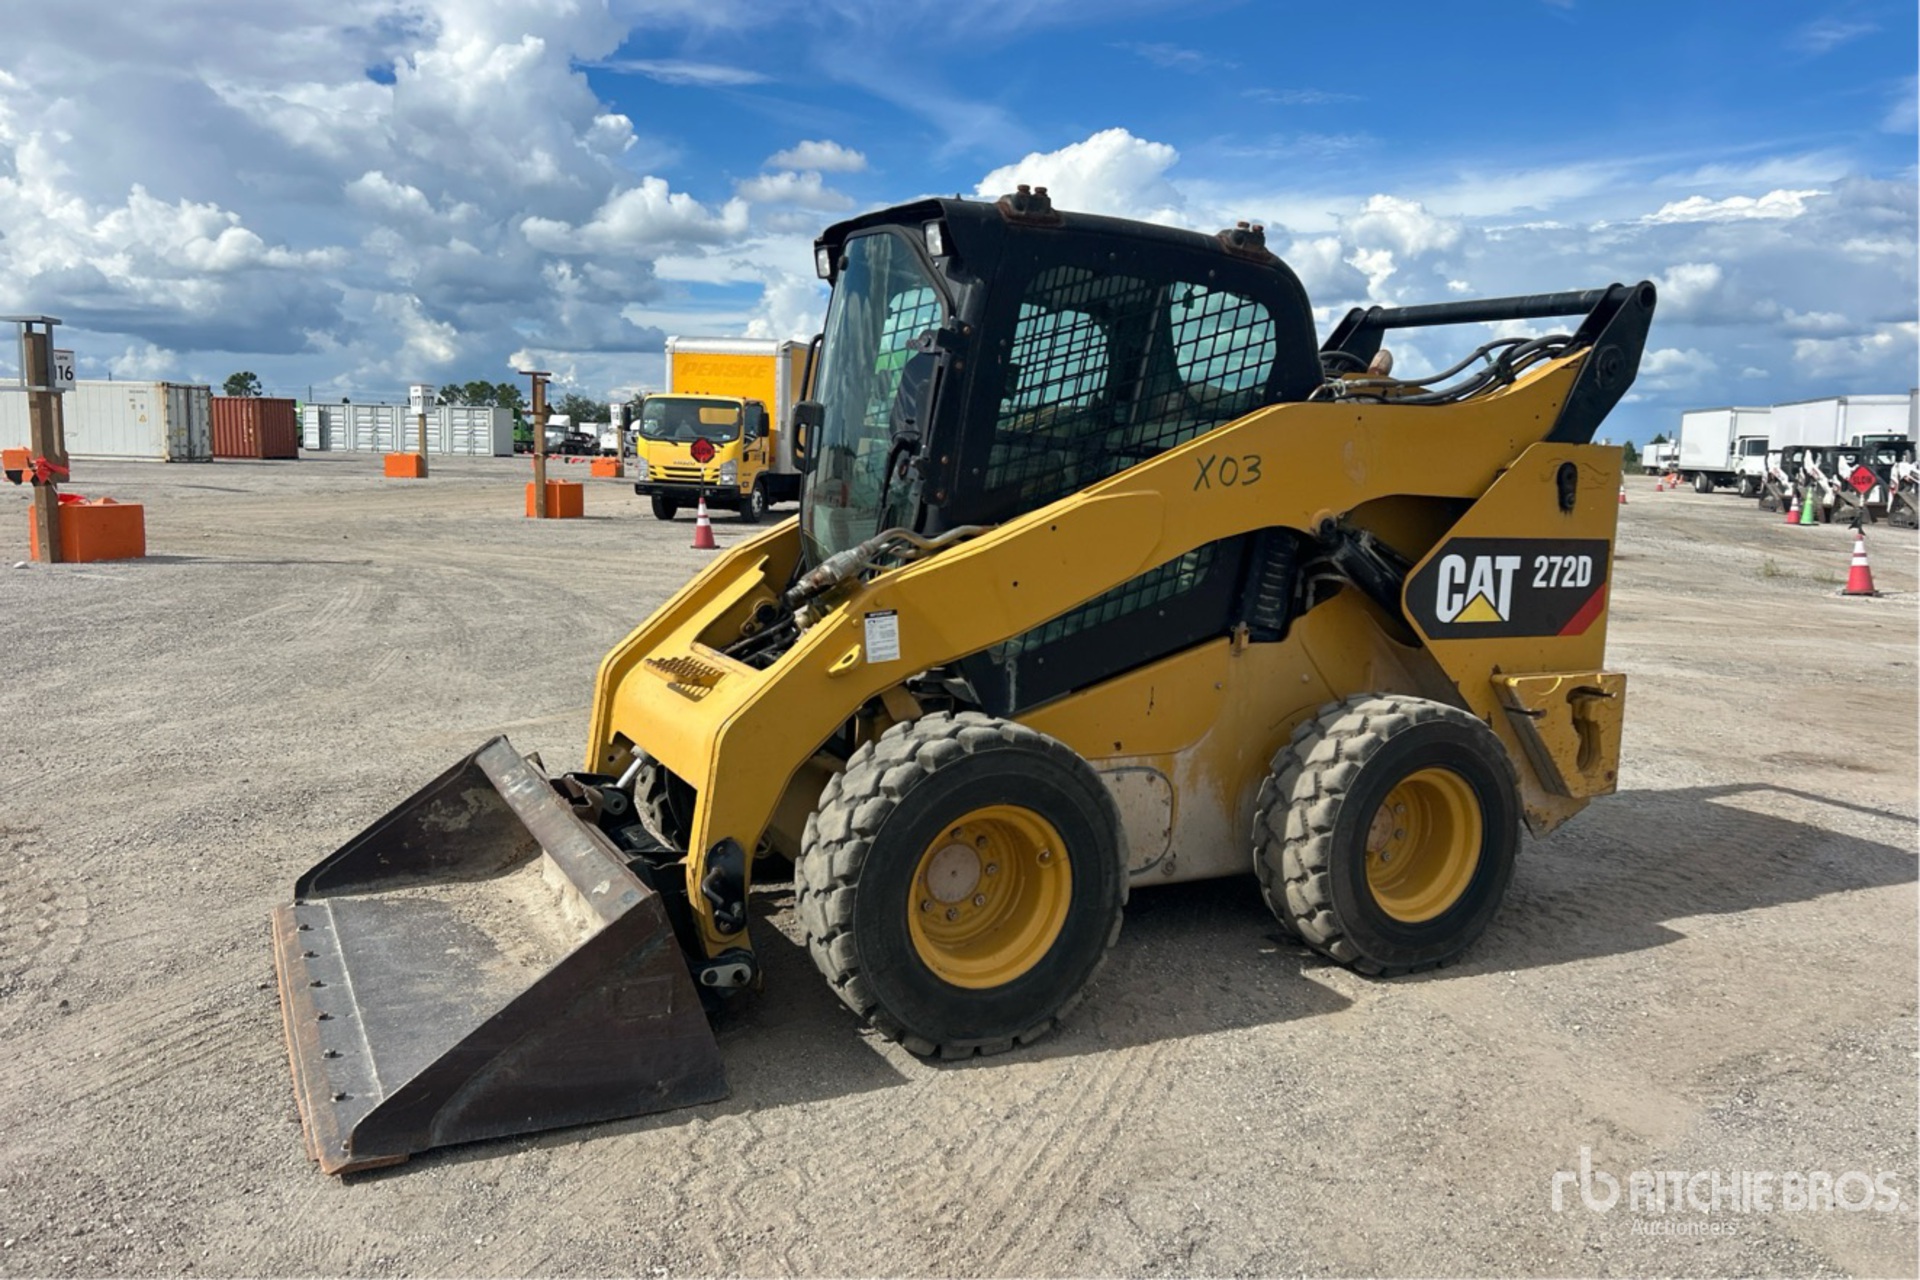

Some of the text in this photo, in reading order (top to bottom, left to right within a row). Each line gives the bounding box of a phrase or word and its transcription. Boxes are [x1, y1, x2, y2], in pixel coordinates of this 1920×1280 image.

[681, 362, 769, 378] PENSKE
[1193, 454, 1261, 491] X03
[1853, 475, 1873, 485] SLOW
[1436, 554, 1592, 623] CAT 272D
